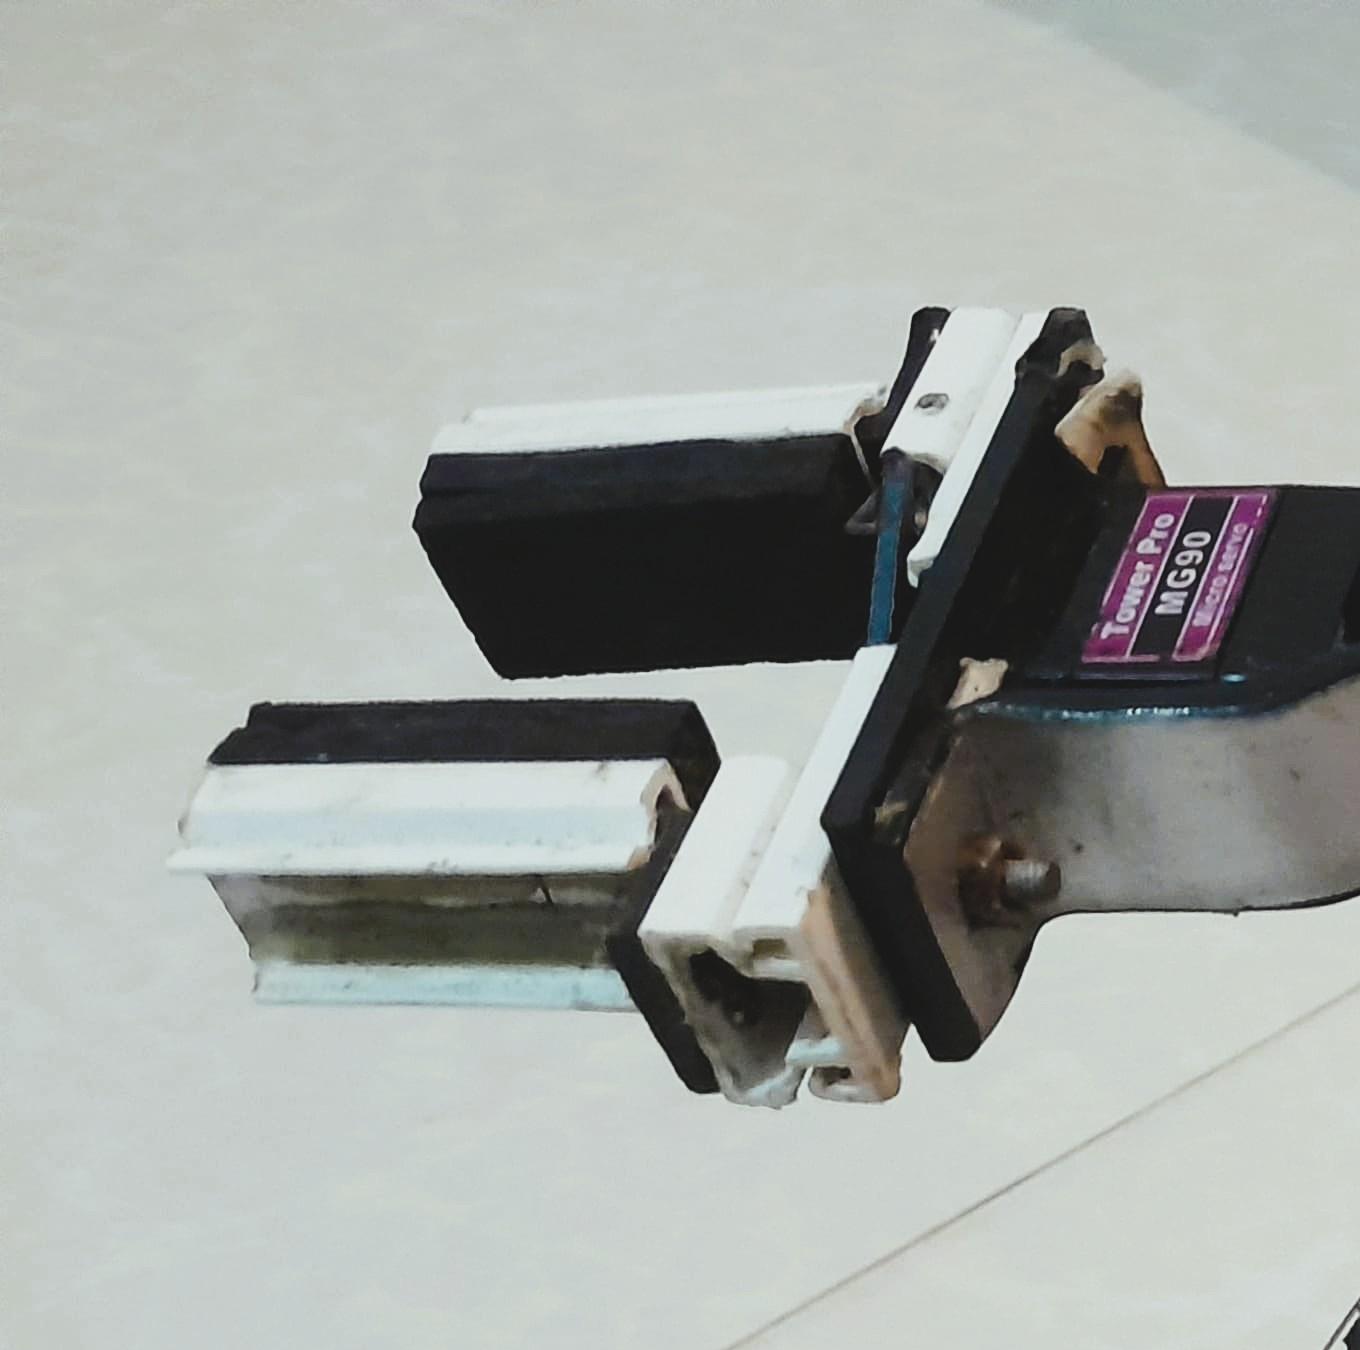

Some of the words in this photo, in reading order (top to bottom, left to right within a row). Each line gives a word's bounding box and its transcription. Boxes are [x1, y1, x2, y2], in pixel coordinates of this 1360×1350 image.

[1100, 560, 1155, 640] Tower
[1136, 513, 1176, 556] Pro
[1154, 530, 1212, 616] MG90
